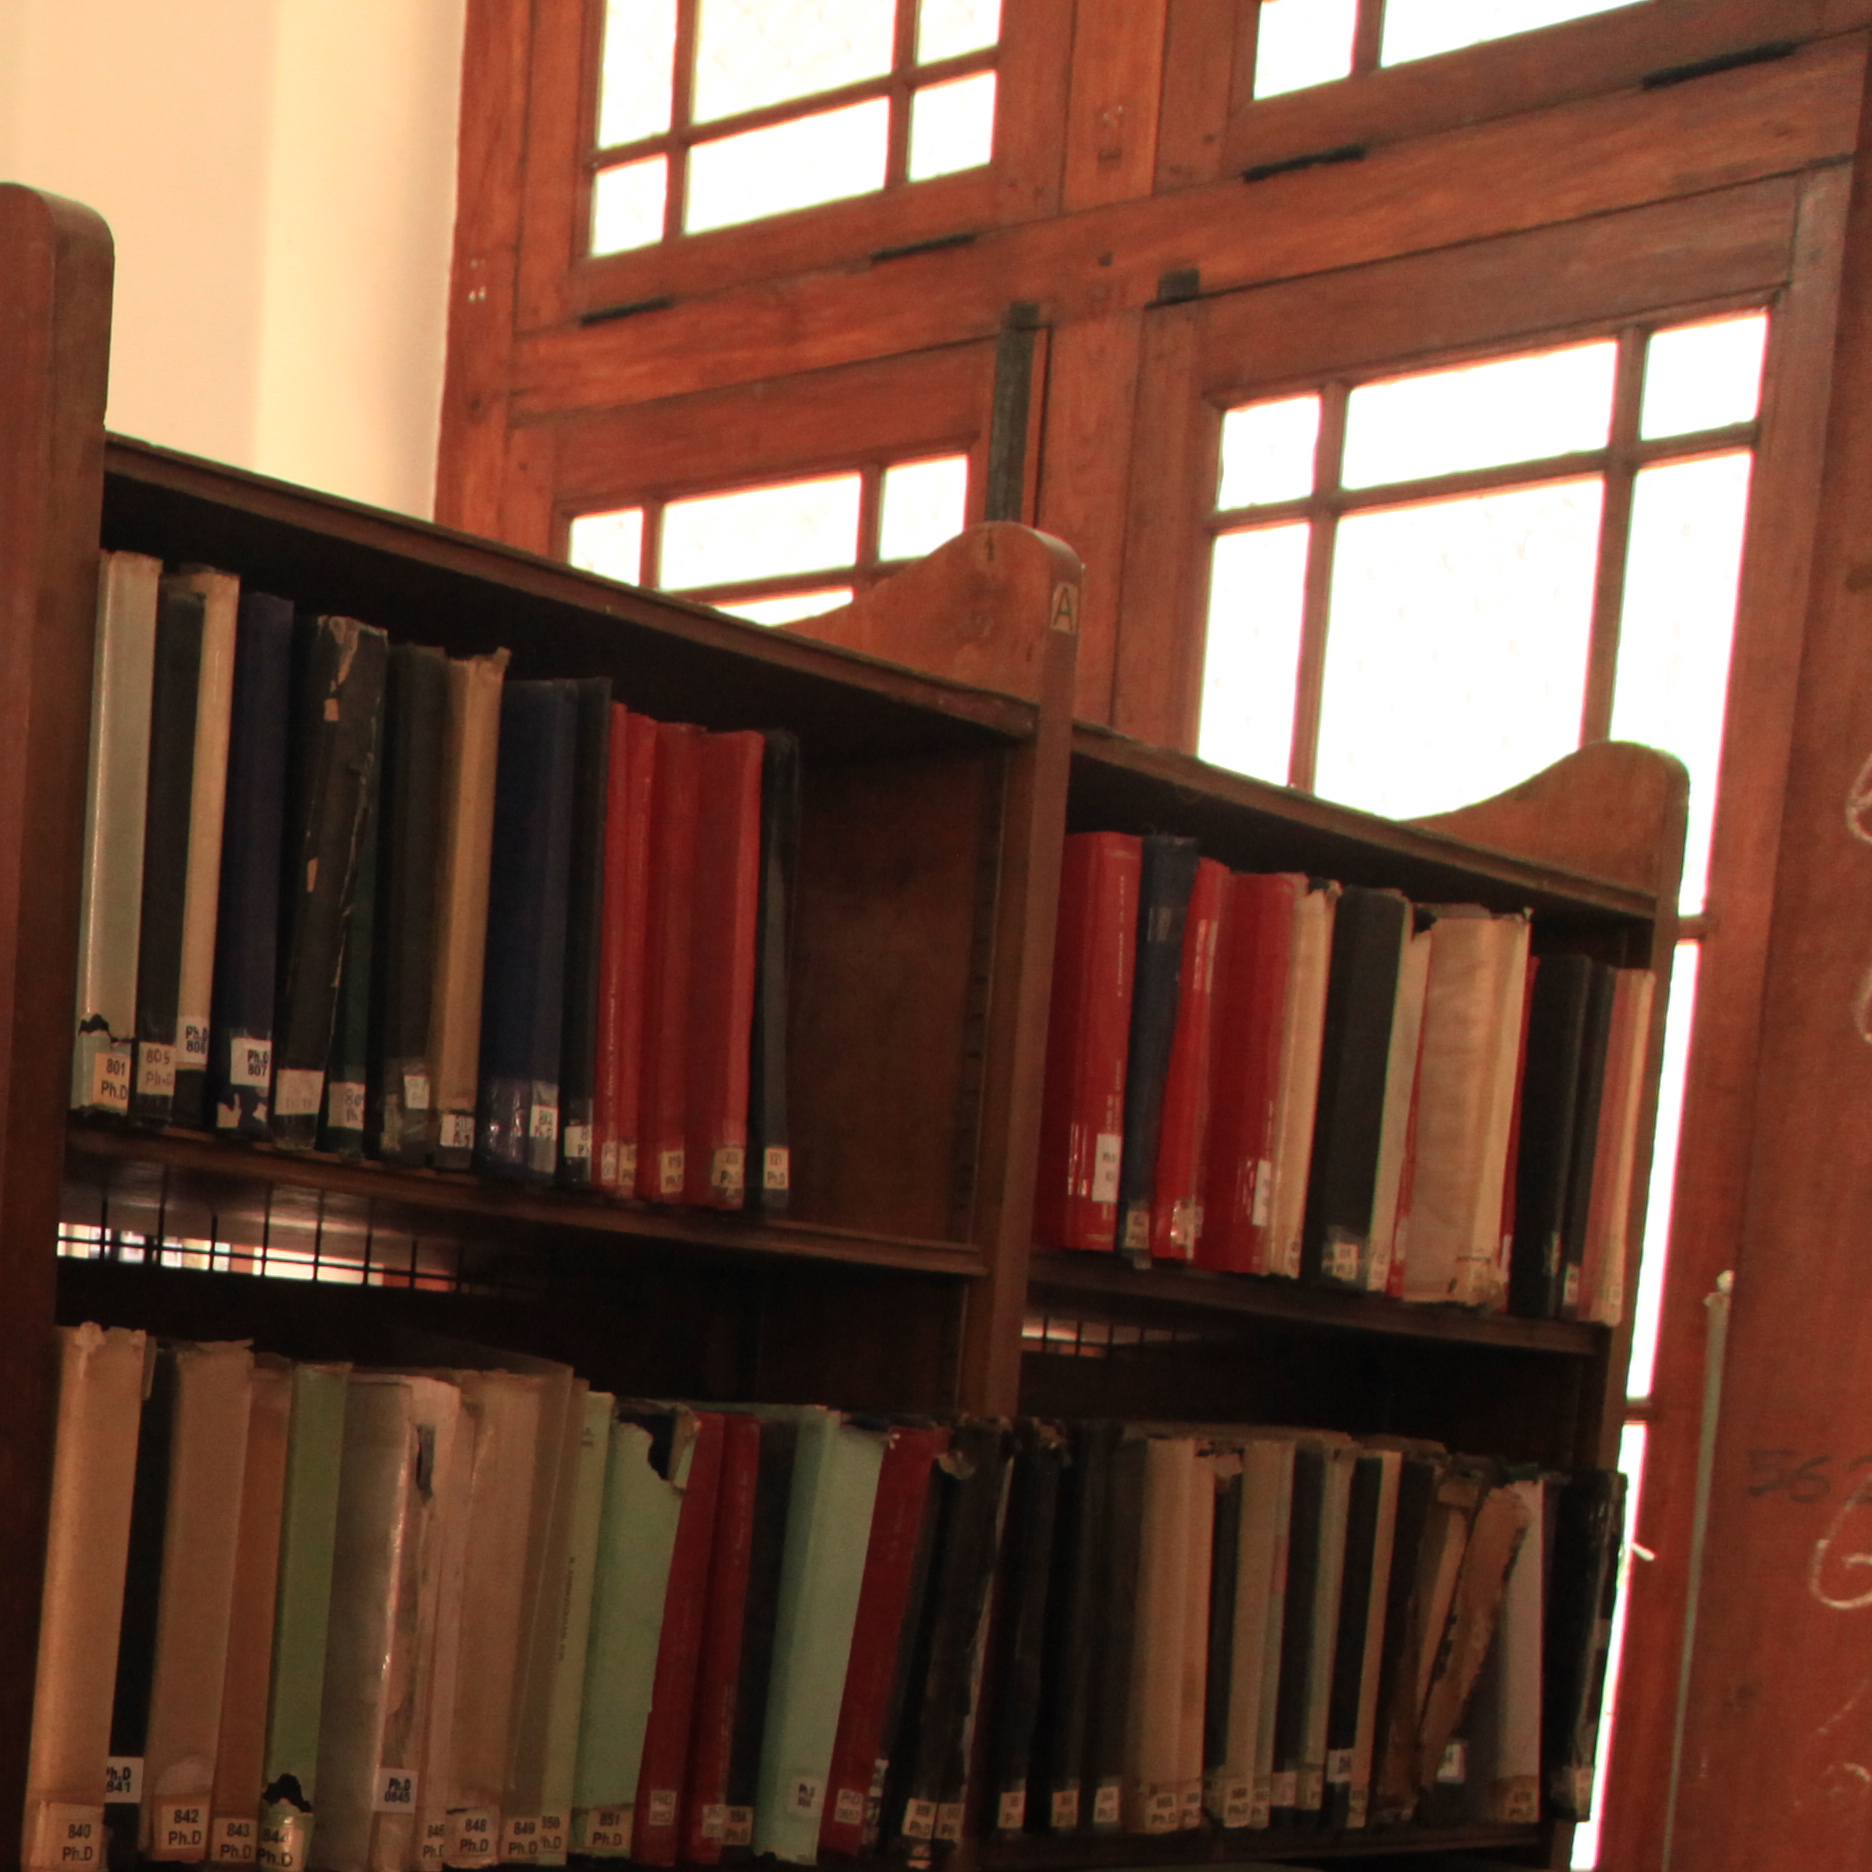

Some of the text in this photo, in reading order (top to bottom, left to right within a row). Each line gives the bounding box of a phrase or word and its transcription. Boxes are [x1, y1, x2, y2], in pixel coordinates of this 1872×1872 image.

[106, 1058, 125, 1076] 801
[101, 1080, 128, 1100] Ph.D
[388, 1778, 411, 1791] Ph.D
[174, 1809, 199, 1823] 842
[599, 1813, 620, 1827] 851
[68, 1824, 91, 1839] 840
[227, 1823, 250, 1838] 843
[465, 1819, 487, 1832] 848
[514, 1822, 535, 1836] 849
[168, 1831, 201, 1846] Ph.D
[459, 1838, 488, 1853] Ph.D
[592, 1832, 622, 1847] Ph.D
[62, 1846, 94, 1861] Ph.D
[220, 1845, 252, 1860] Ph.D
[508, 1840, 537, 1855] Ph.D
[257, 1850, 293, 1867] Ph.D
